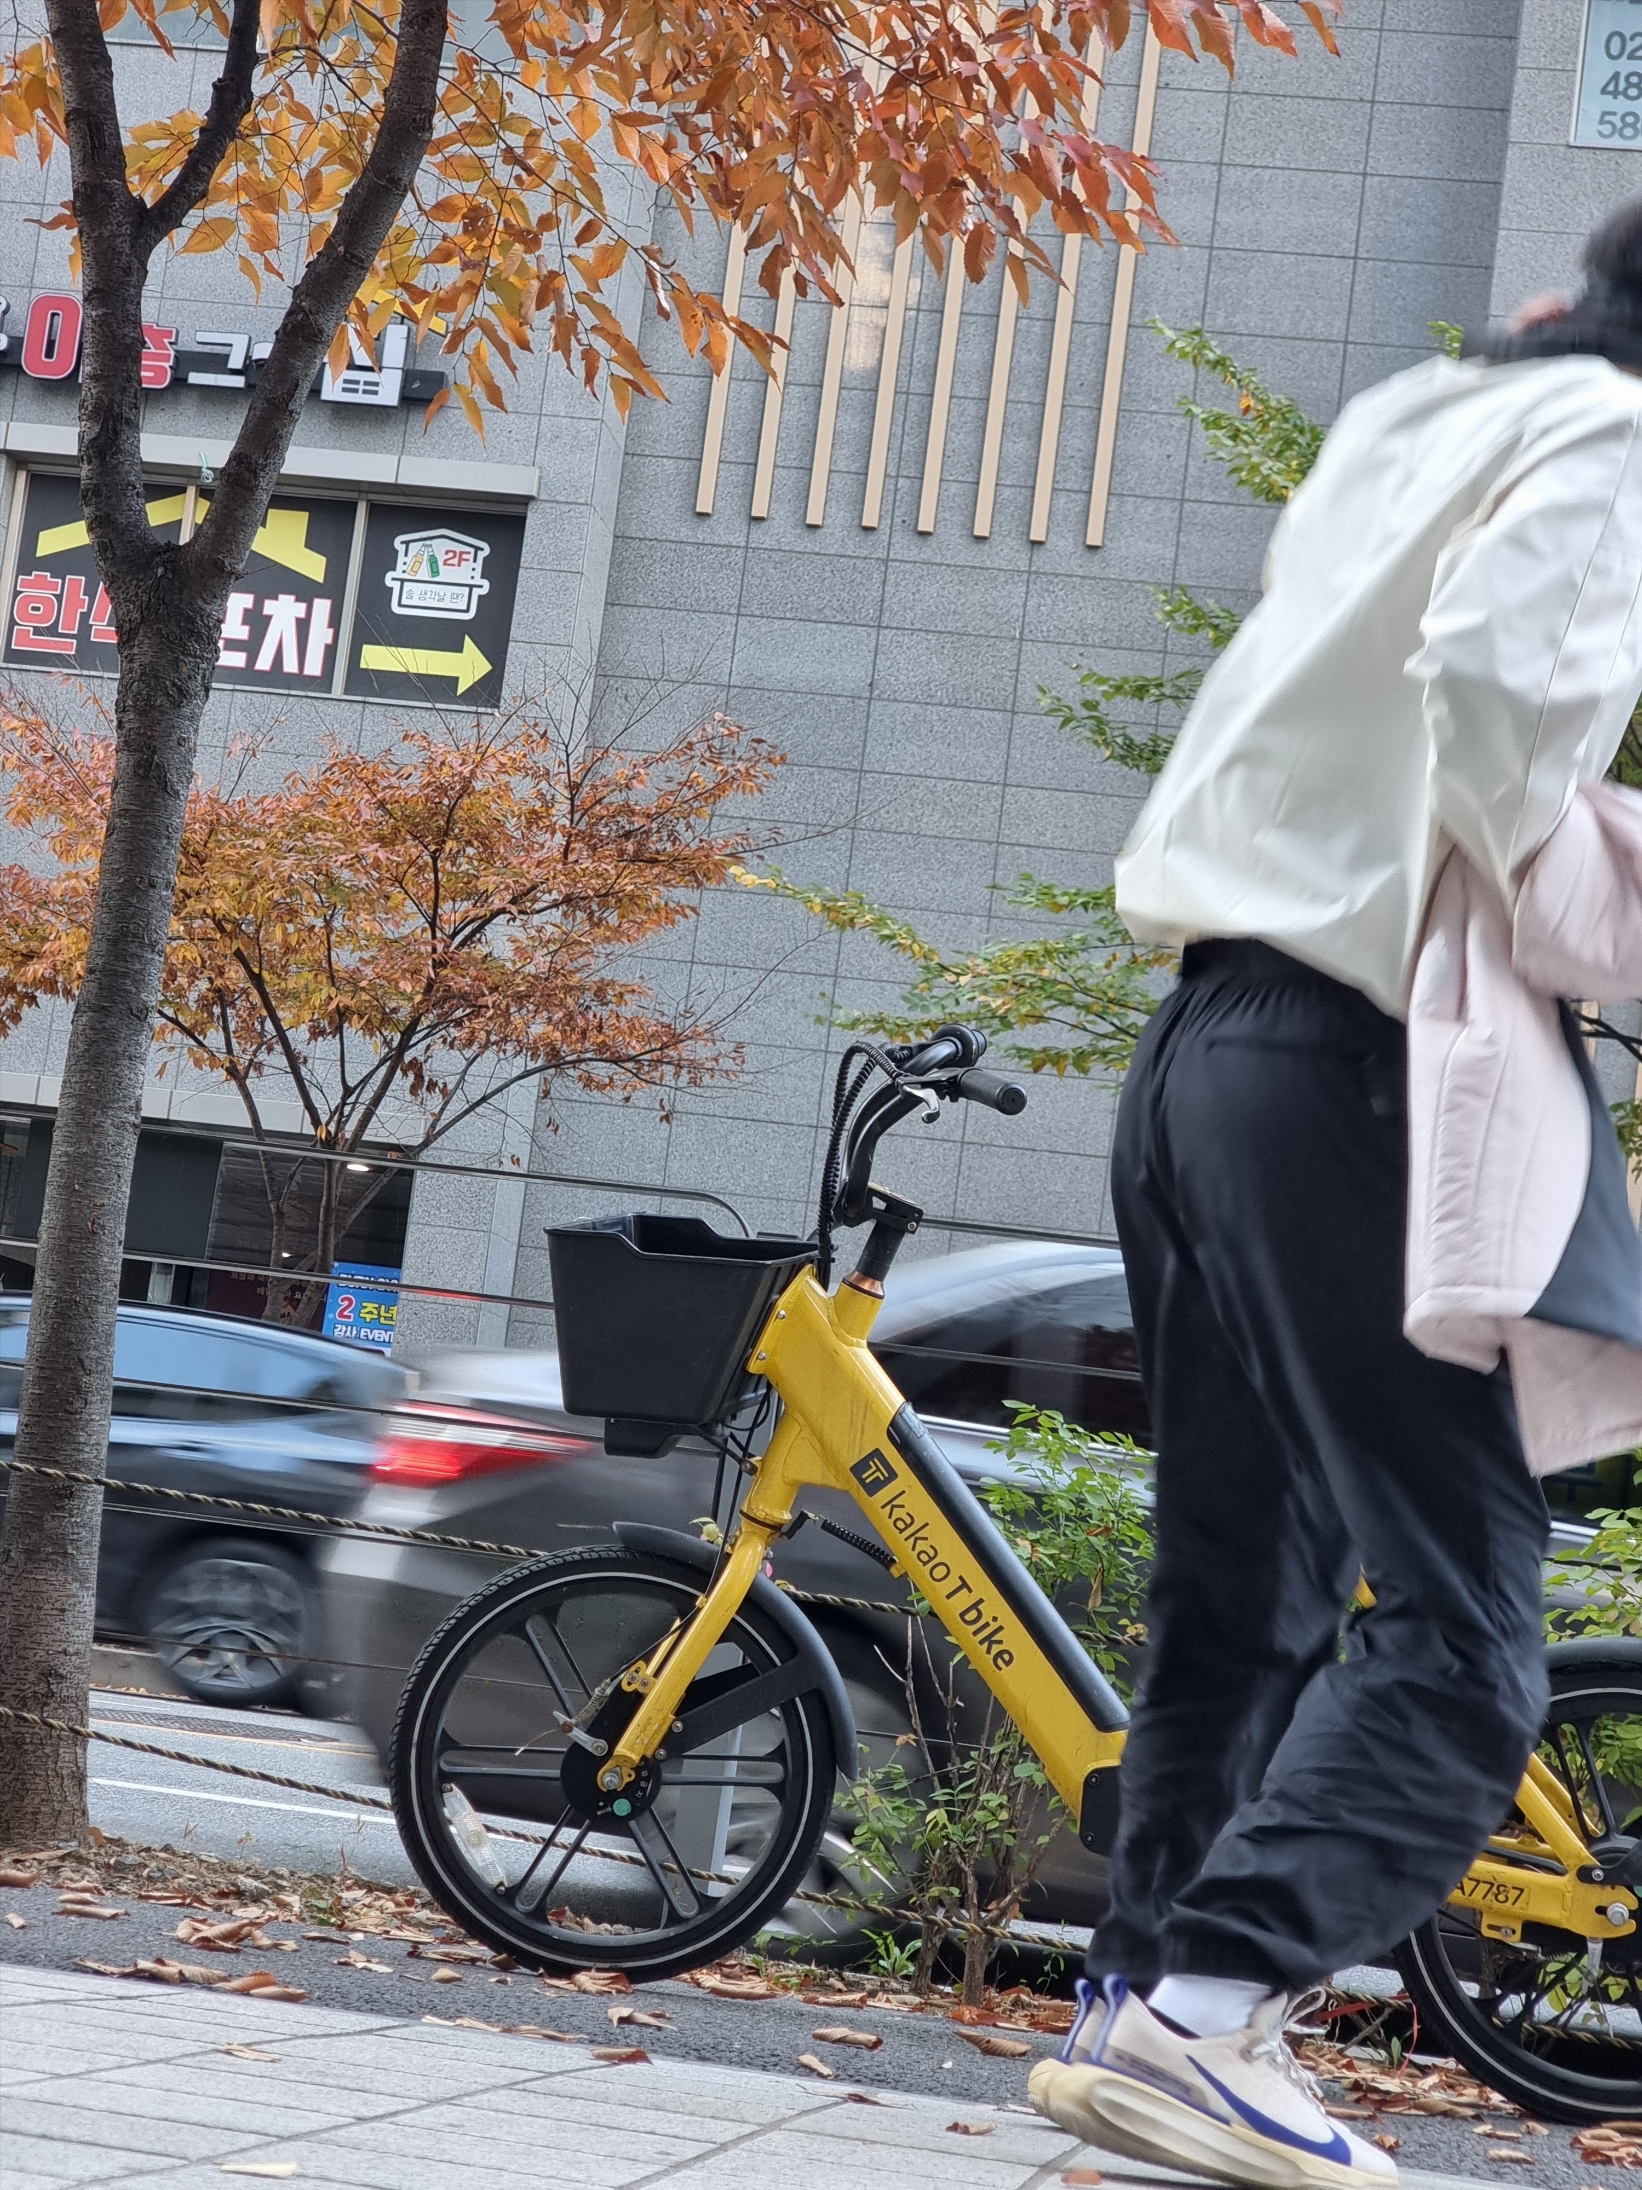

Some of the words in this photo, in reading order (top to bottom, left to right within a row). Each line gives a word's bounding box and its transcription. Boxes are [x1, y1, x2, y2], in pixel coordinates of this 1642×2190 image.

[1597, 111, 1642, 141] 58
[443, 549, 471, 567] 2F
[405, 588, 414, 600] 술
[336, 1294, 356, 1322] 2
[334, 1324, 358, 1339] 감사
[880, 1489, 952, 1583] kakao
[945, 1575, 973, 1601] T
[958, 1597, 1015, 1672] bike
